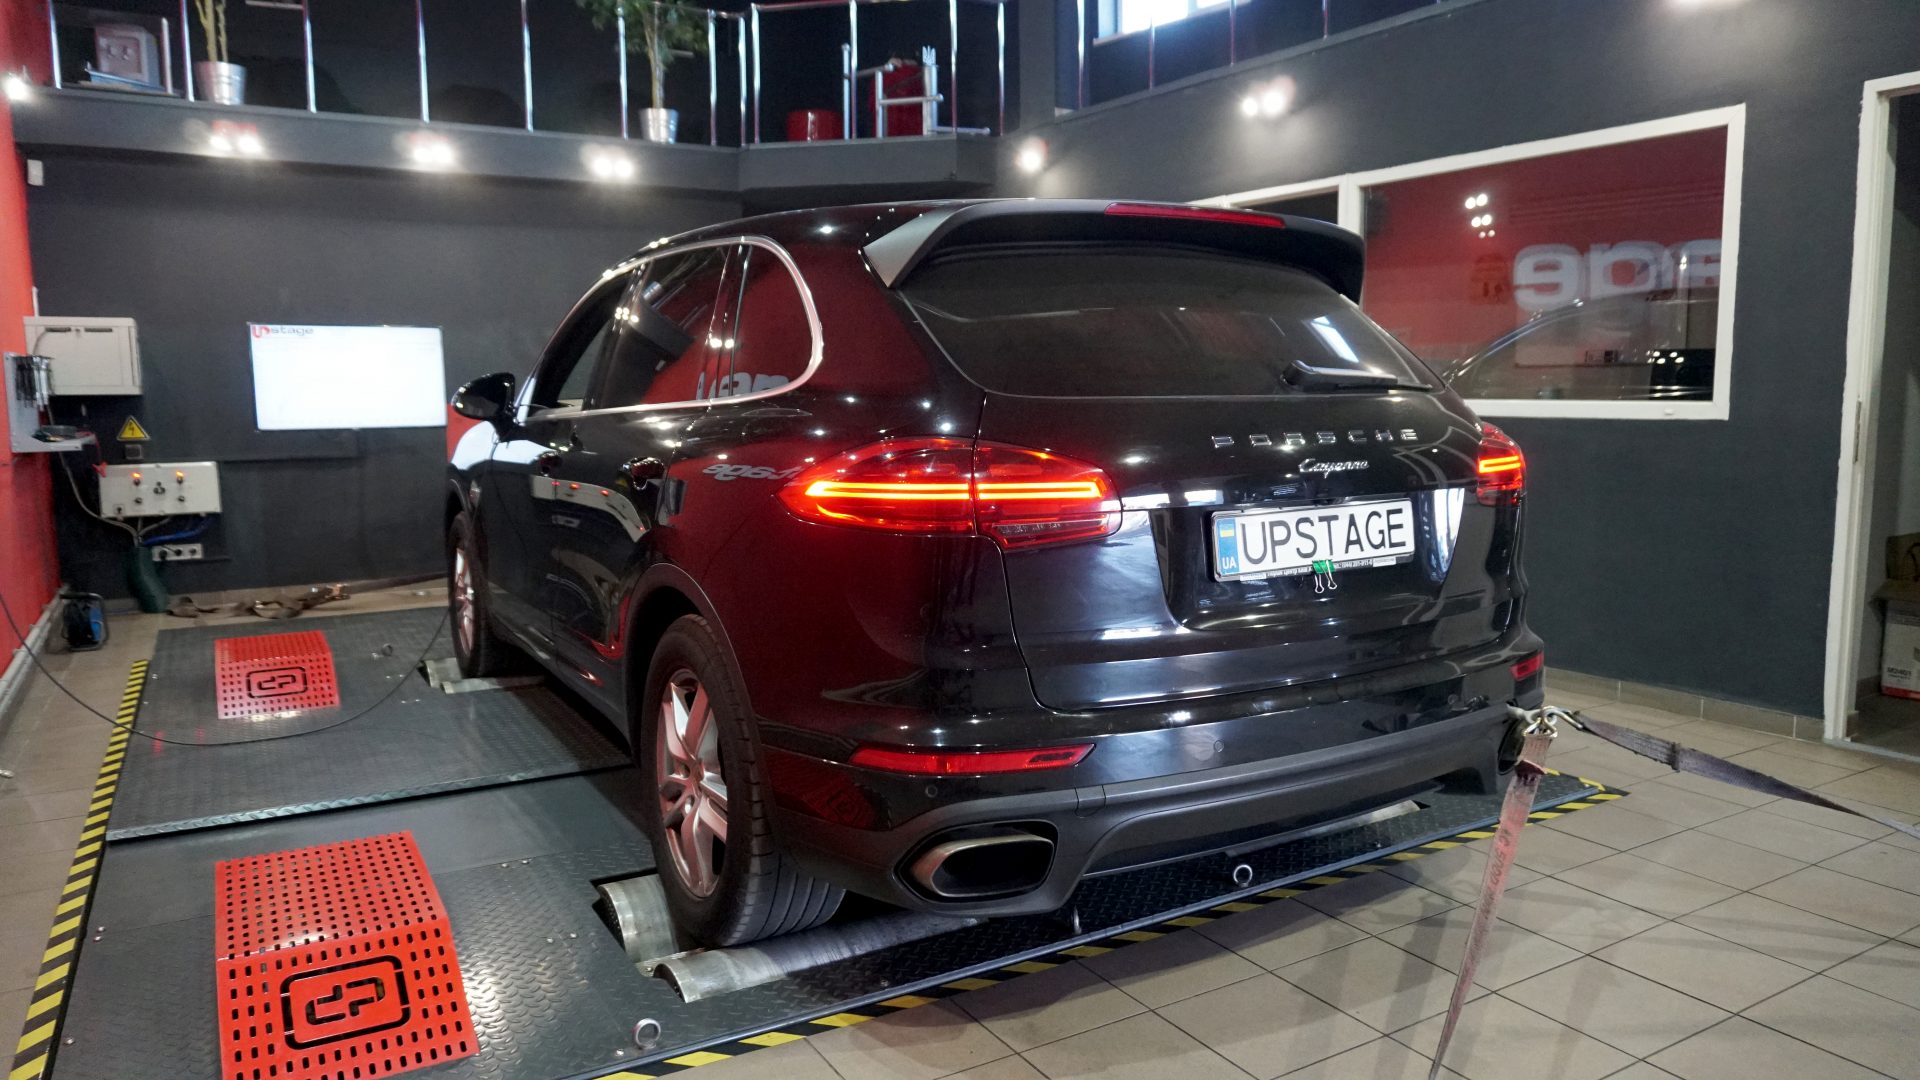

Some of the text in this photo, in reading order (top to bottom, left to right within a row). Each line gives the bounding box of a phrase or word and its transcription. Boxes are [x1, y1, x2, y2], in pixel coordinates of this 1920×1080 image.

[1211, 428, 1418, 448] PORSCHE
[1298, 458, 1370, 478] Cayenne
[1241, 508, 1406, 565] UPSTAGE
[1222, 556, 1237, 569] UA
